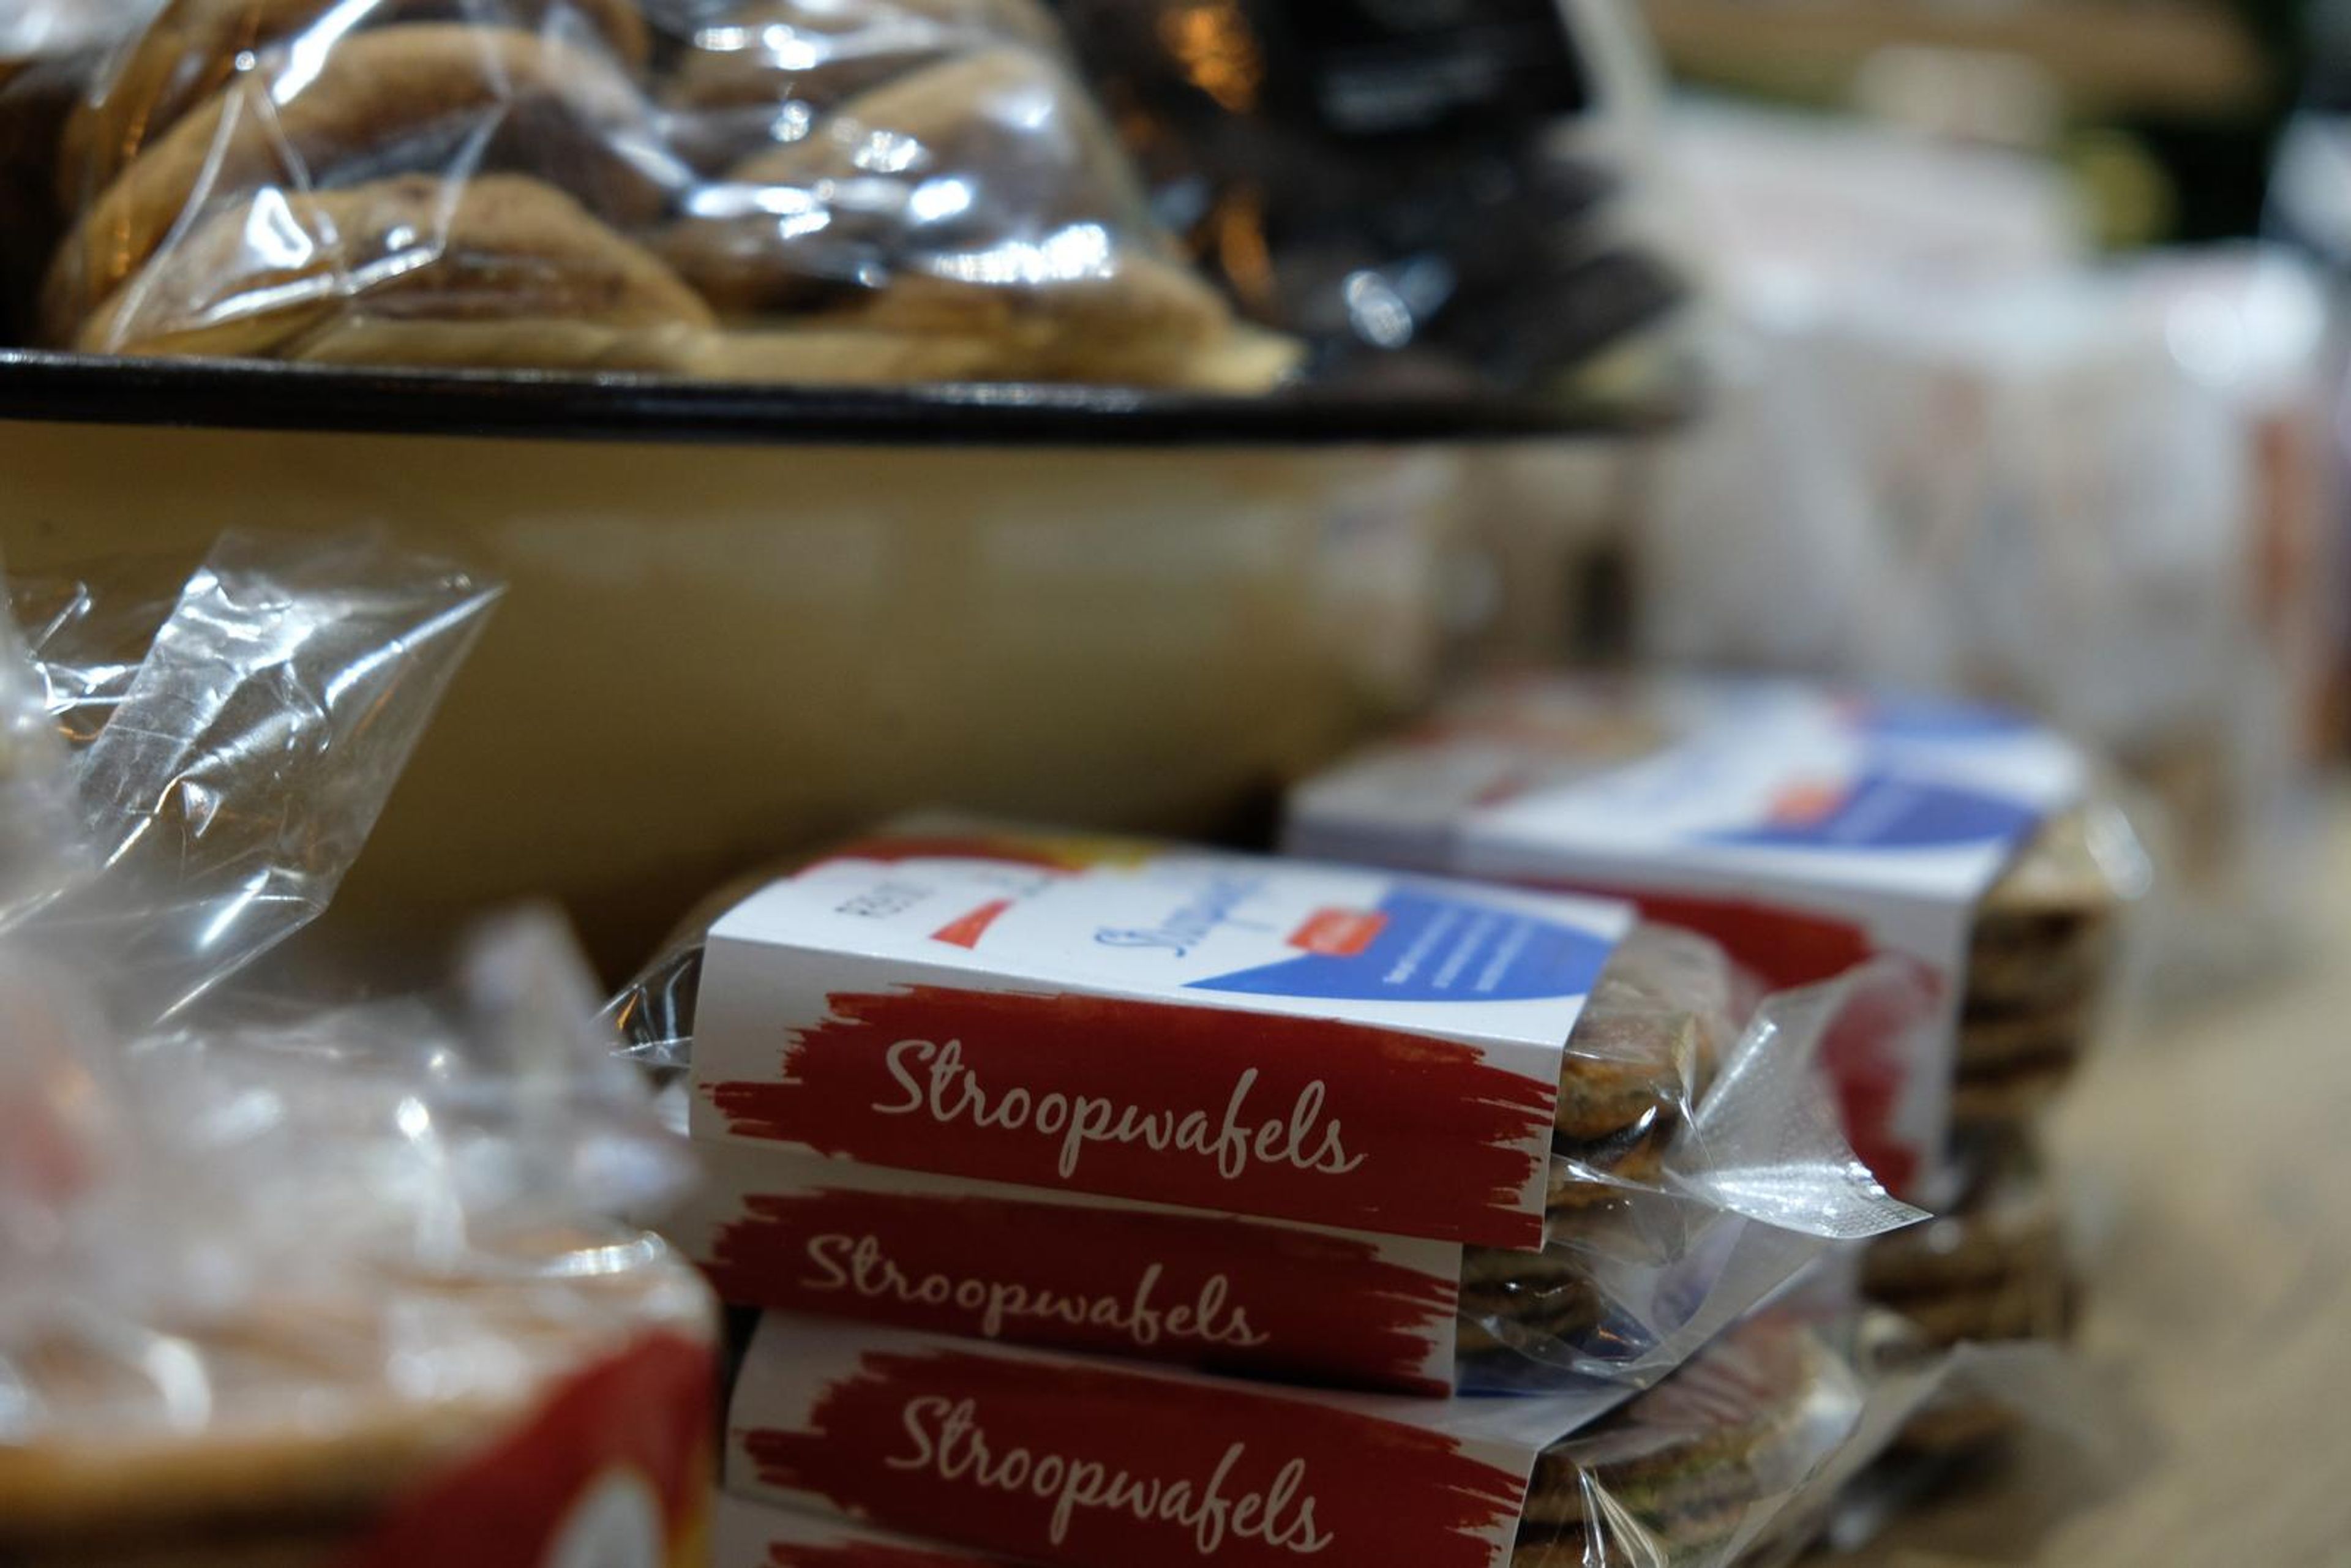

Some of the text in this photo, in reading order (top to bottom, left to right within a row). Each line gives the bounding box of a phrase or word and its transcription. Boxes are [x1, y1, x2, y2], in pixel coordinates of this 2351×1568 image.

[872, 1038, 1368, 1179] Stroopwafels
[802, 1233, 1270, 1344] Stroopwafels
[885, 1396, 1334, 1554] Stroopwafels
